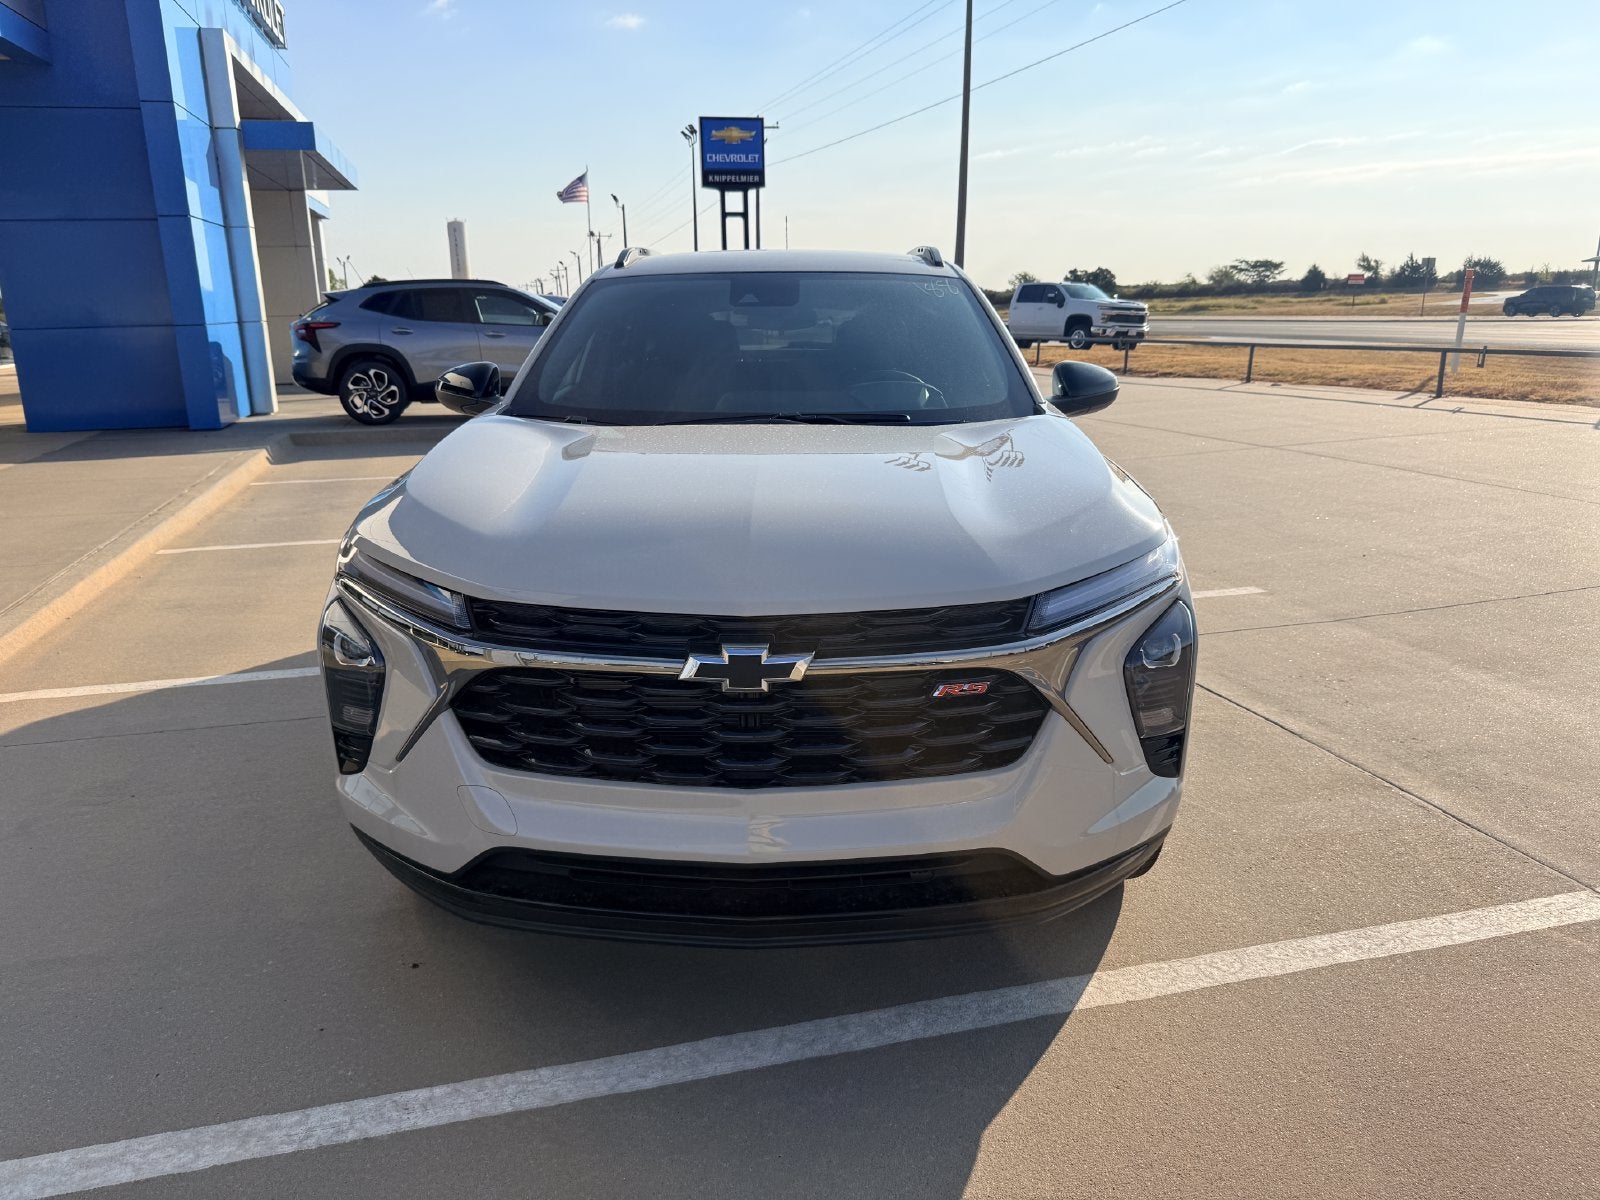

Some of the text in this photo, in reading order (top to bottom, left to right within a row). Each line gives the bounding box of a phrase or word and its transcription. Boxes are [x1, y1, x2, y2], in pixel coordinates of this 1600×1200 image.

[706, 153, 760, 163] CHEVROLET
[708, 174, 760, 183] KNIPPELMIER
[932, 681, 991, 697] RS
